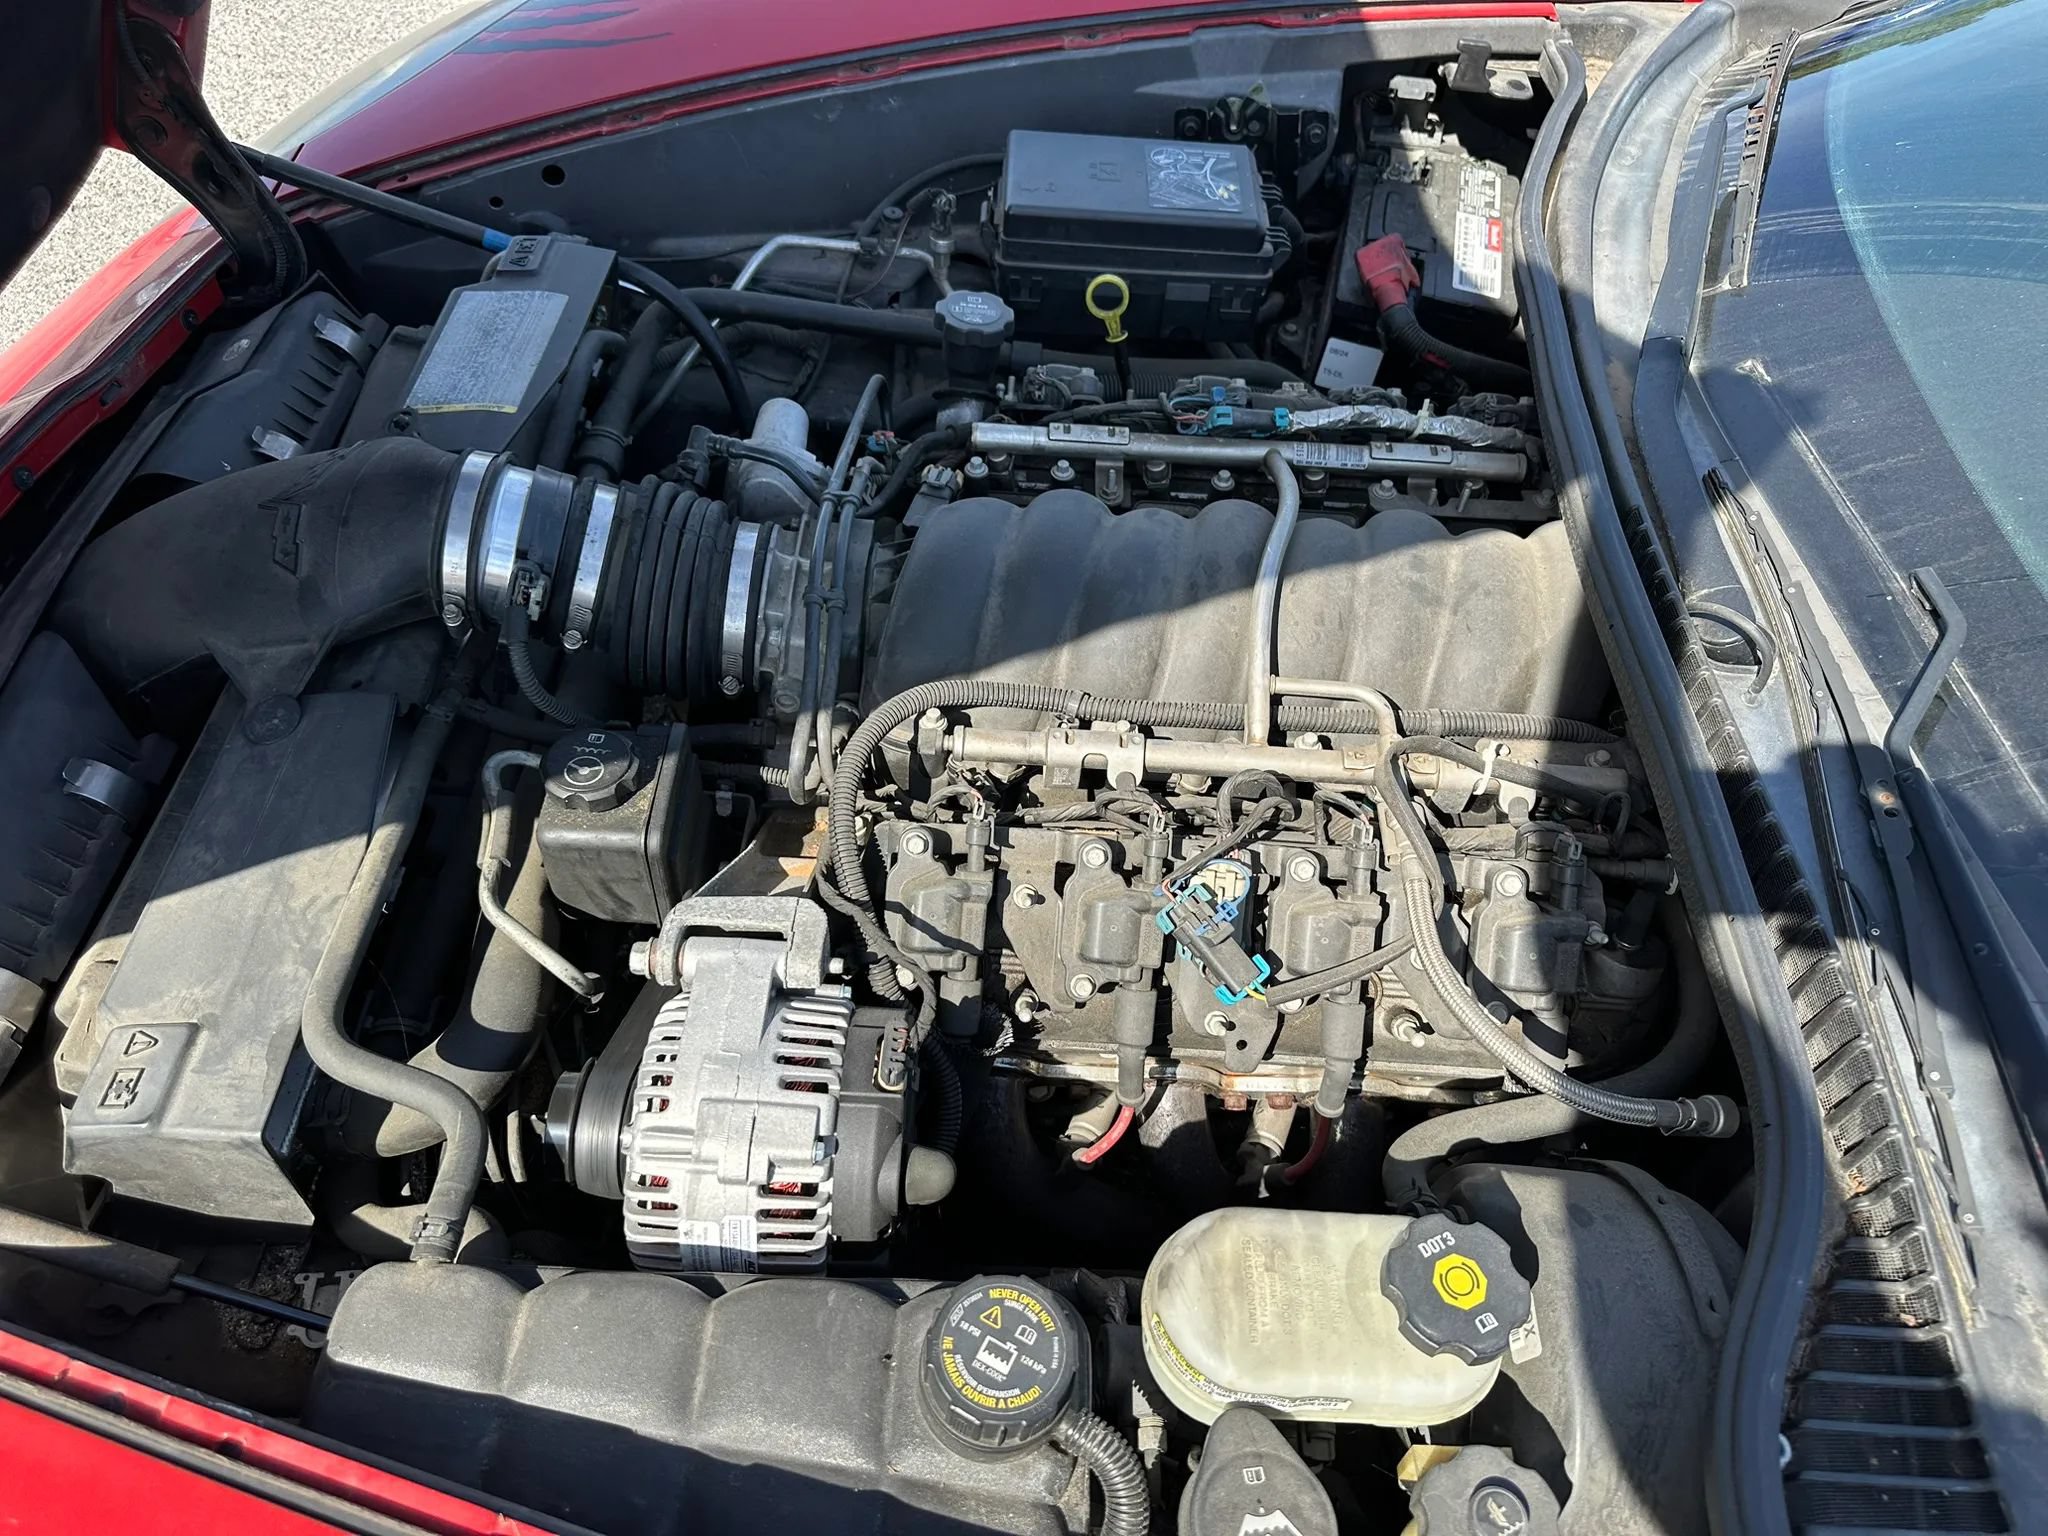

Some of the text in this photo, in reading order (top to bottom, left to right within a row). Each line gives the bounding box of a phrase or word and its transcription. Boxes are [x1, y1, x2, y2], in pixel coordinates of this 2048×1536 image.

[989, 1288, 1019, 1299] NEVER
[1019, 1293, 1041, 1314] OPEN
[1038, 1310, 1056, 1332] HOT!
[1004, 1299, 1039, 1323] SURGE TANK
[942, 1336, 954, 1350] NE
[968, 1325, 982, 1337] PSI
[943, 1351, 966, 1388] JAMAIS
[1020, 1354, 1047, 1374] 124 kPa
[961, 1384, 997, 1408] OUVRIR
[976, 1383, 1021, 1398] D'EXPANSION
[1007, 1385, 1043, 1409] CHAUD!
